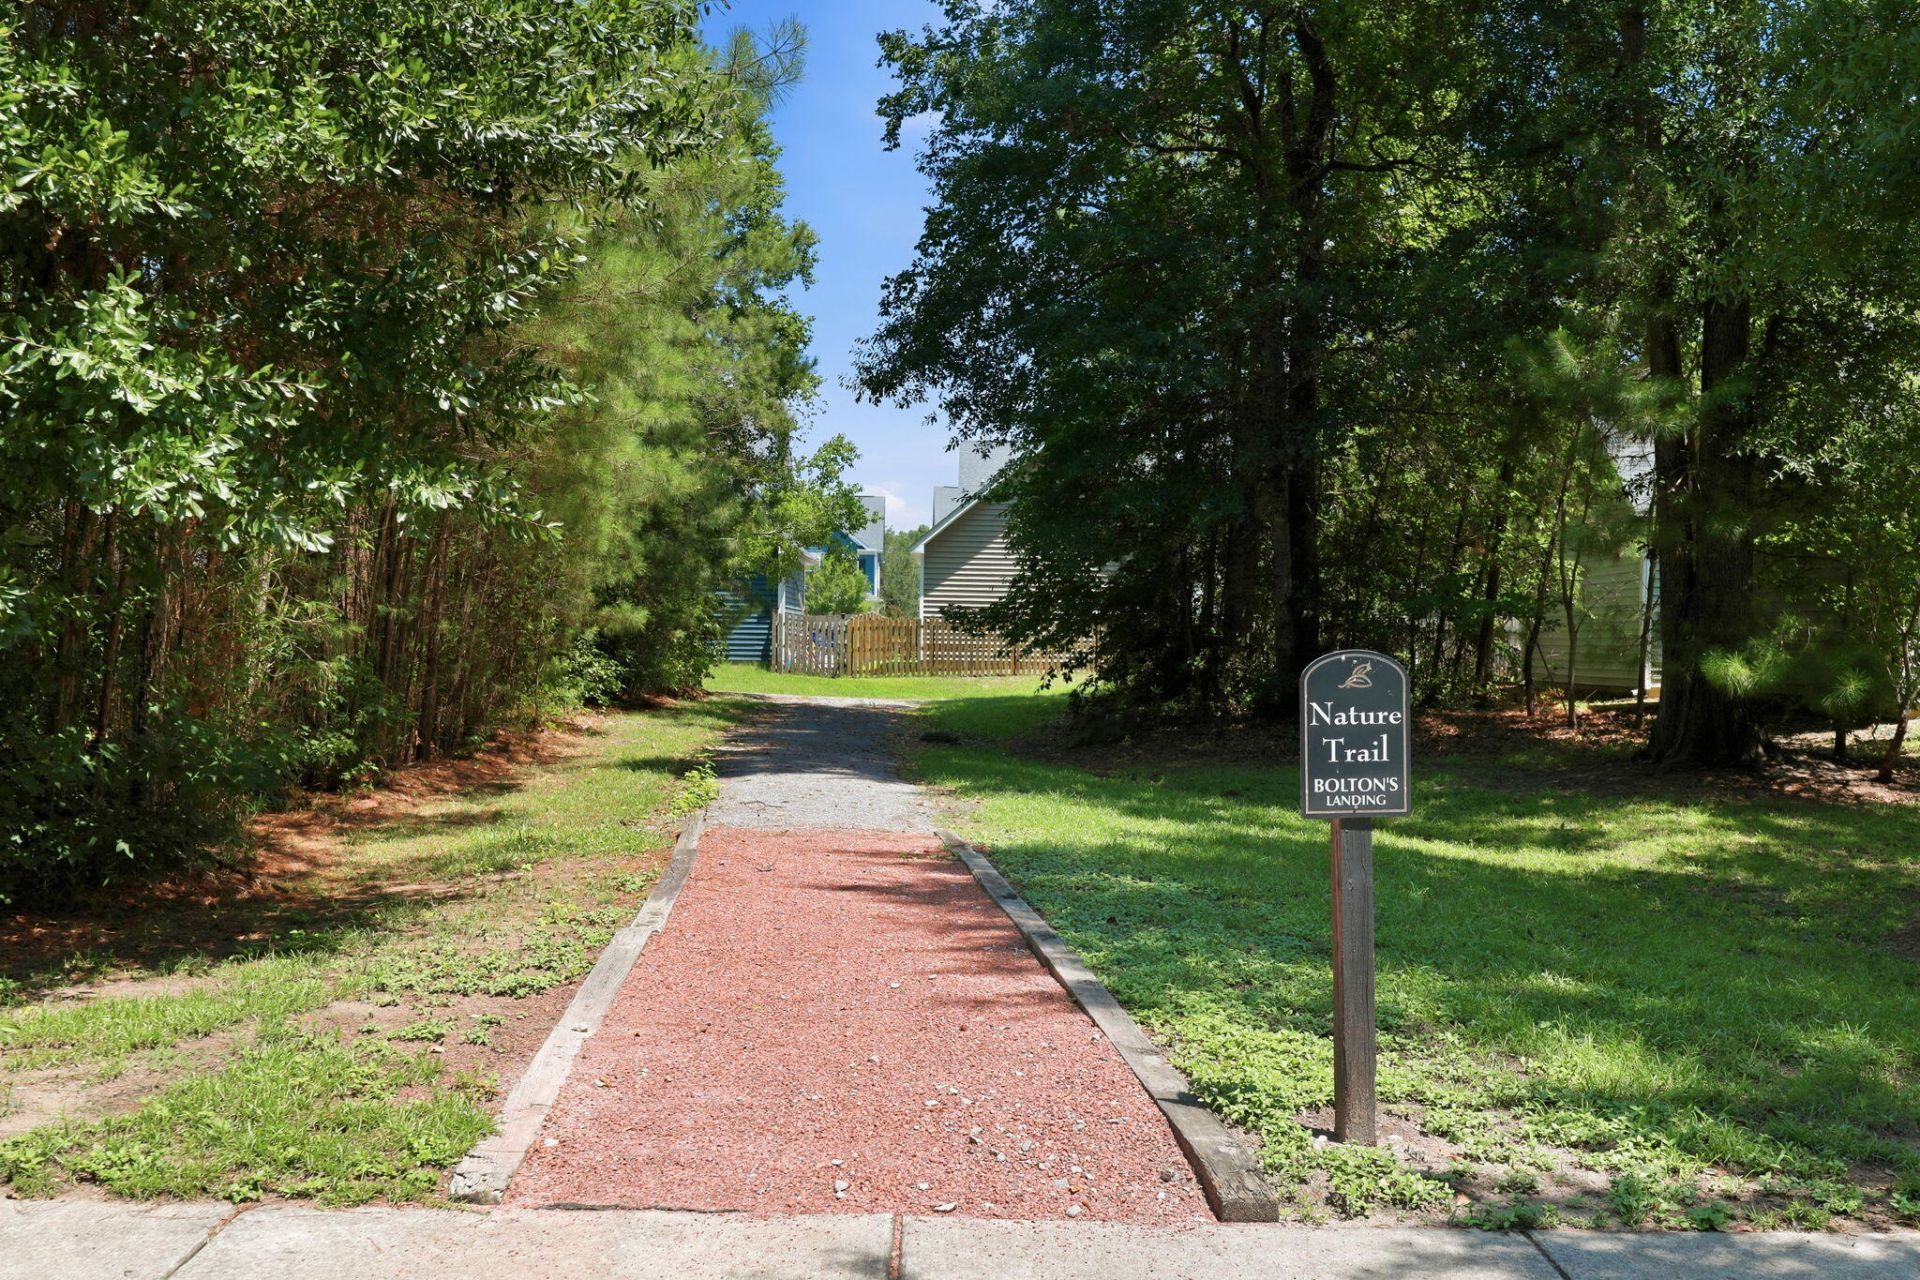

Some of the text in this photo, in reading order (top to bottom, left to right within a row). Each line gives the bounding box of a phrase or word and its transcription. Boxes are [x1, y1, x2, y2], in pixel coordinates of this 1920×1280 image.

[1309, 701, 1402, 726] Nature
[1322, 733, 1390, 763] Trail
[1314, 777, 1399, 793] BOLTON'S
[1326, 794, 1387, 806] LANDING
